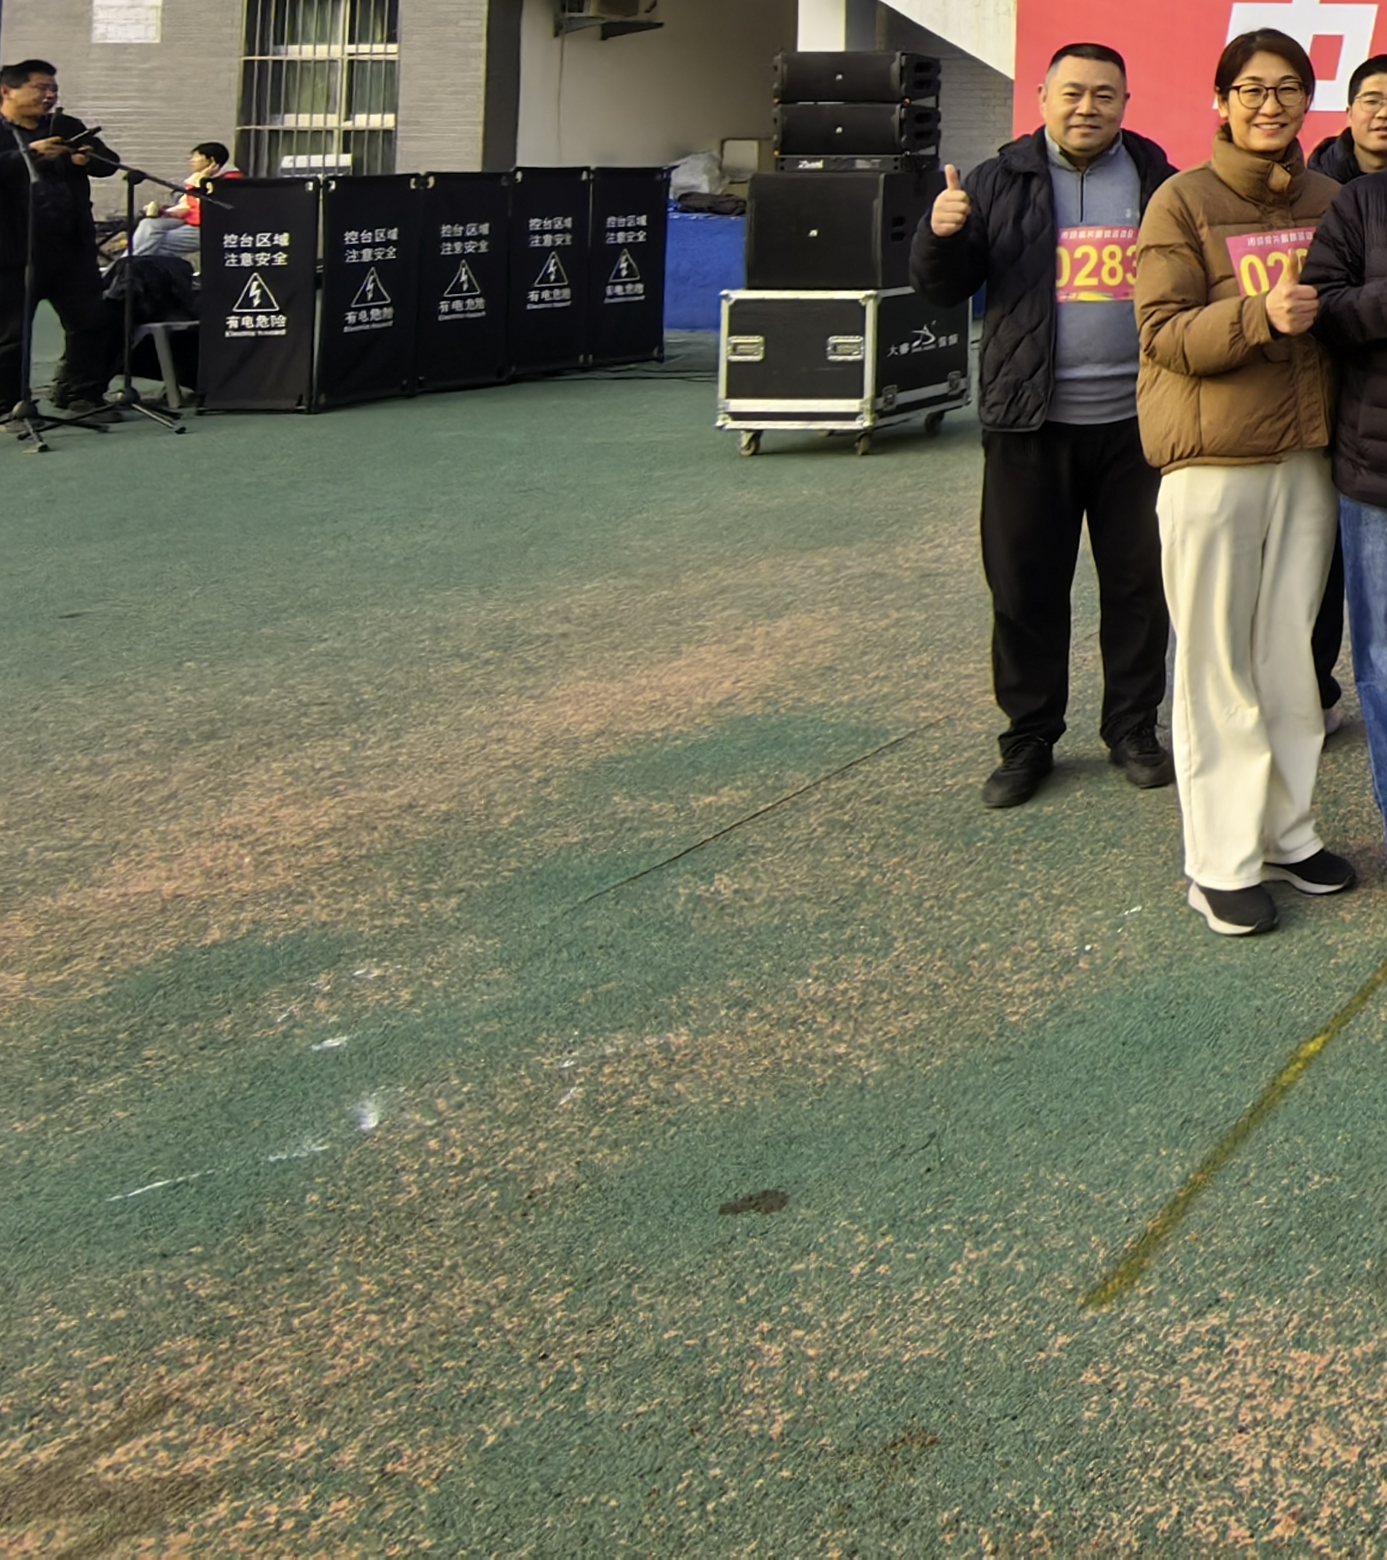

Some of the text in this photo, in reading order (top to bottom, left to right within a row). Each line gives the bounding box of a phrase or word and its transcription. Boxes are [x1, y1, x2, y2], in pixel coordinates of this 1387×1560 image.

[343, 227, 398, 245] 控台区域
[440, 223, 490, 237] 控台区域
[223, 232, 290, 248] 控台区域
[440, 241, 489, 255] 注意安全
[225, 251, 288, 267] 注意安全
[345, 246, 397, 263] 注意安全
[225, 315, 287, 329] 有电危险
